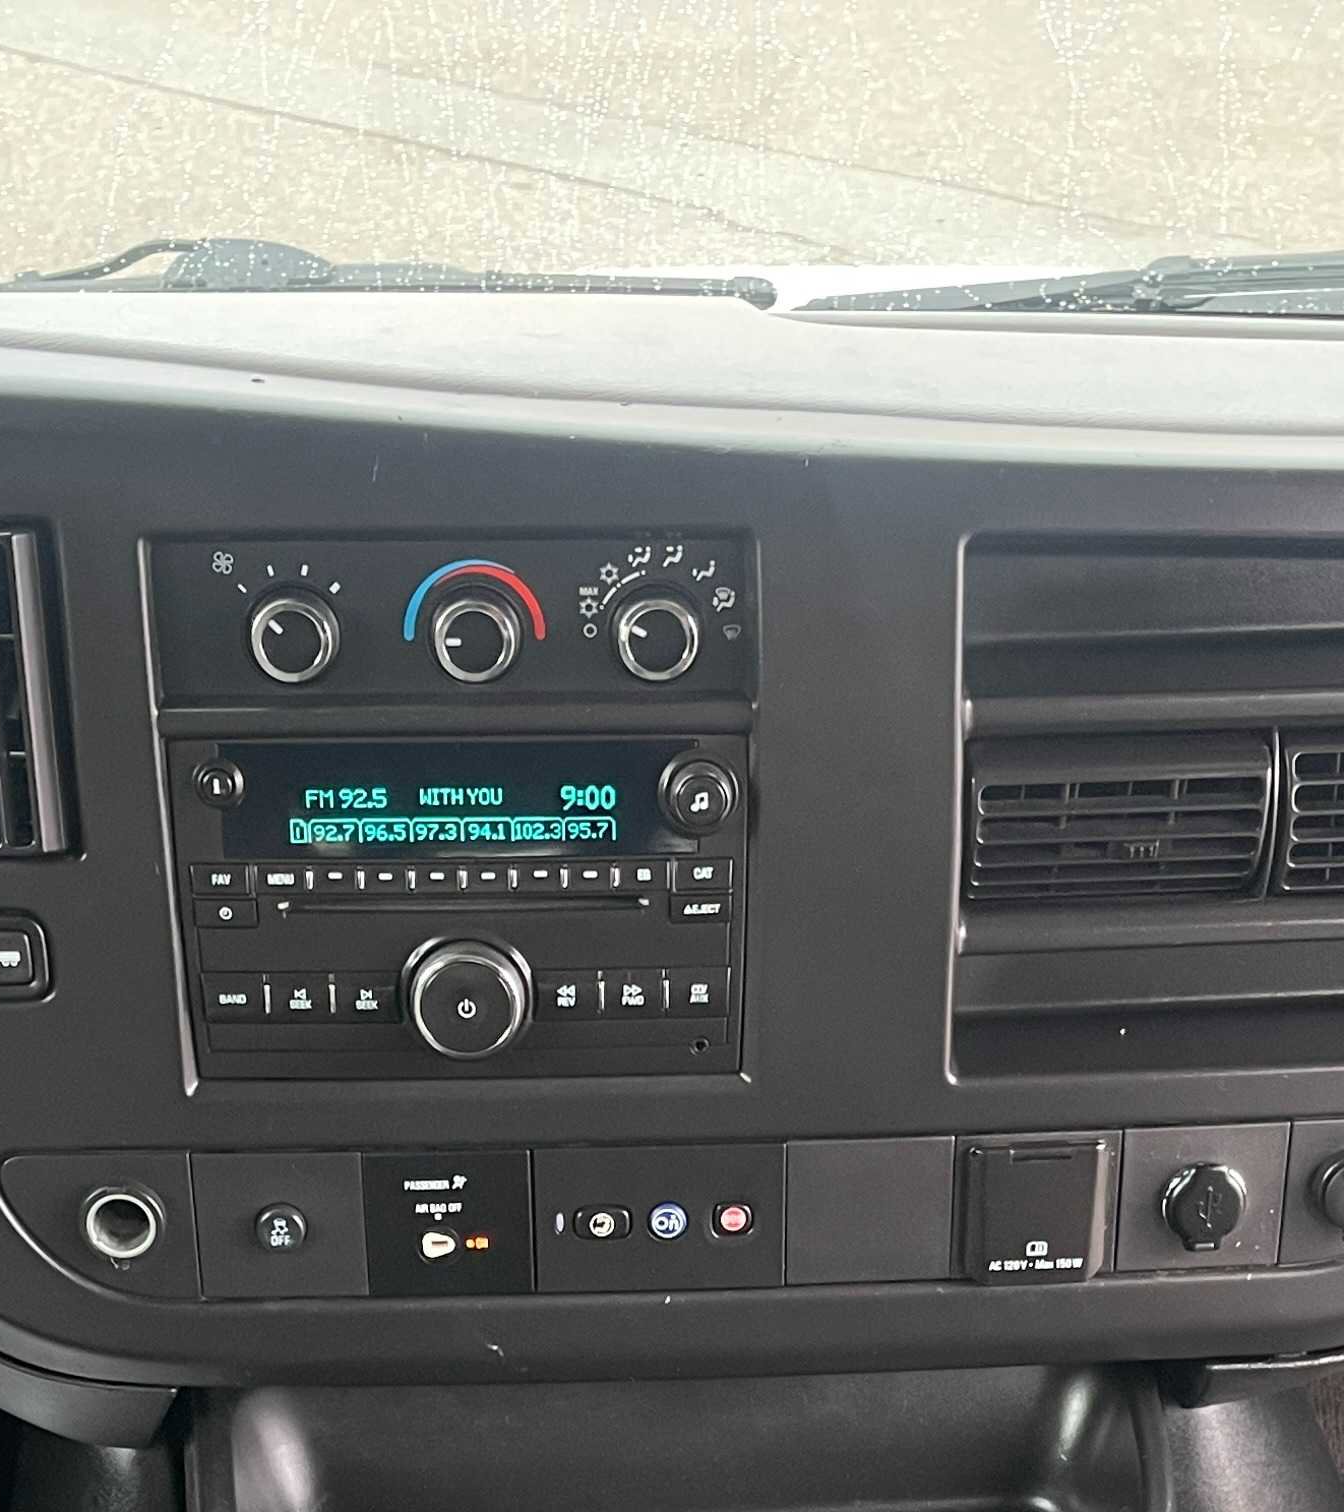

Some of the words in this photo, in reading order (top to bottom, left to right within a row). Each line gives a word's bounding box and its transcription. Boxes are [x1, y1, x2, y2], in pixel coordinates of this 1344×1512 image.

[305, 789, 335, 808] FM
[341, 788, 387, 808] 92.5
[419, 788, 463, 806] WITH
[467, 788, 503, 806] YOU
[560, 785, 616, 810] 9:00
[313, 824, 355, 842] 92.7
[364, 823, 406, 841] 96.5
[415, 823, 457, 841] 97.3
[467, 823, 506, 841] 94.1
[515, 823, 562, 841] 102.3
[568, 823, 609, 840] 95.7
[211, 873, 231, 886] FAV
[267, 873, 295, 886] MENU
[693, 866, 714, 880] CAT
[219, 993, 247, 1005] BAND
[448, 1202, 462, 1212] OFF
[270, 1235, 291, 1247] OFF
